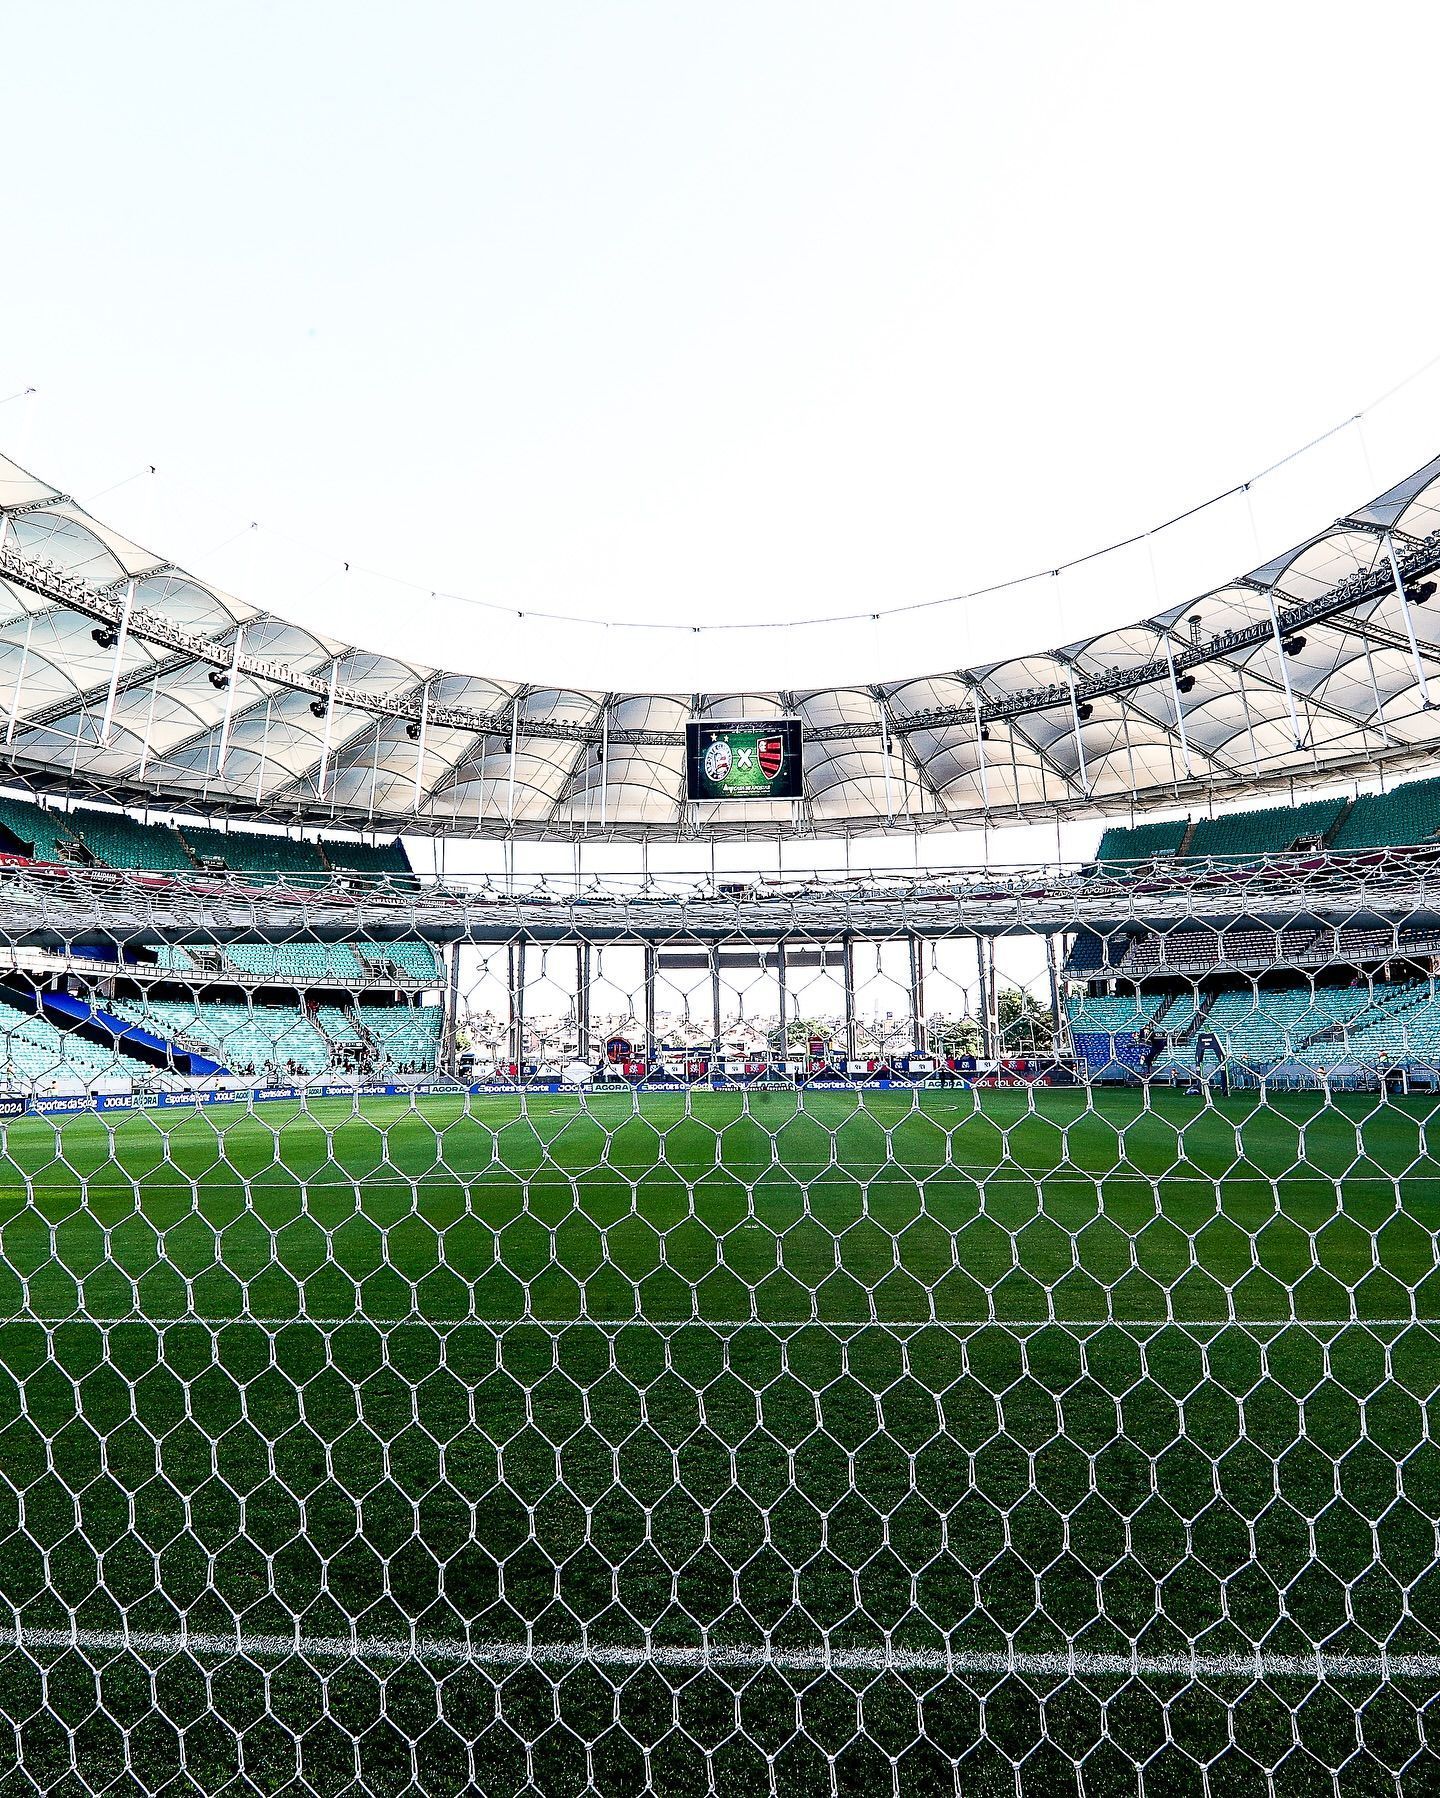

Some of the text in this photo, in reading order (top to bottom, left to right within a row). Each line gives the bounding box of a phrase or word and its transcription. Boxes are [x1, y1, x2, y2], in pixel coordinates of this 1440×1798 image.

[558, 1084, 592, 1092] JOGUE
[856, 1081, 880, 1089] Sorte
[197, 1093, 210, 1102] orte
[214, 1092, 253, 1101] JOGUE AGO
[67, 1099, 77, 1109] da
[77, 1098, 97, 1108] Soe
[104, 1097, 132, 1108] JOGUE
[0, 1102, 22, 1114] 2024
